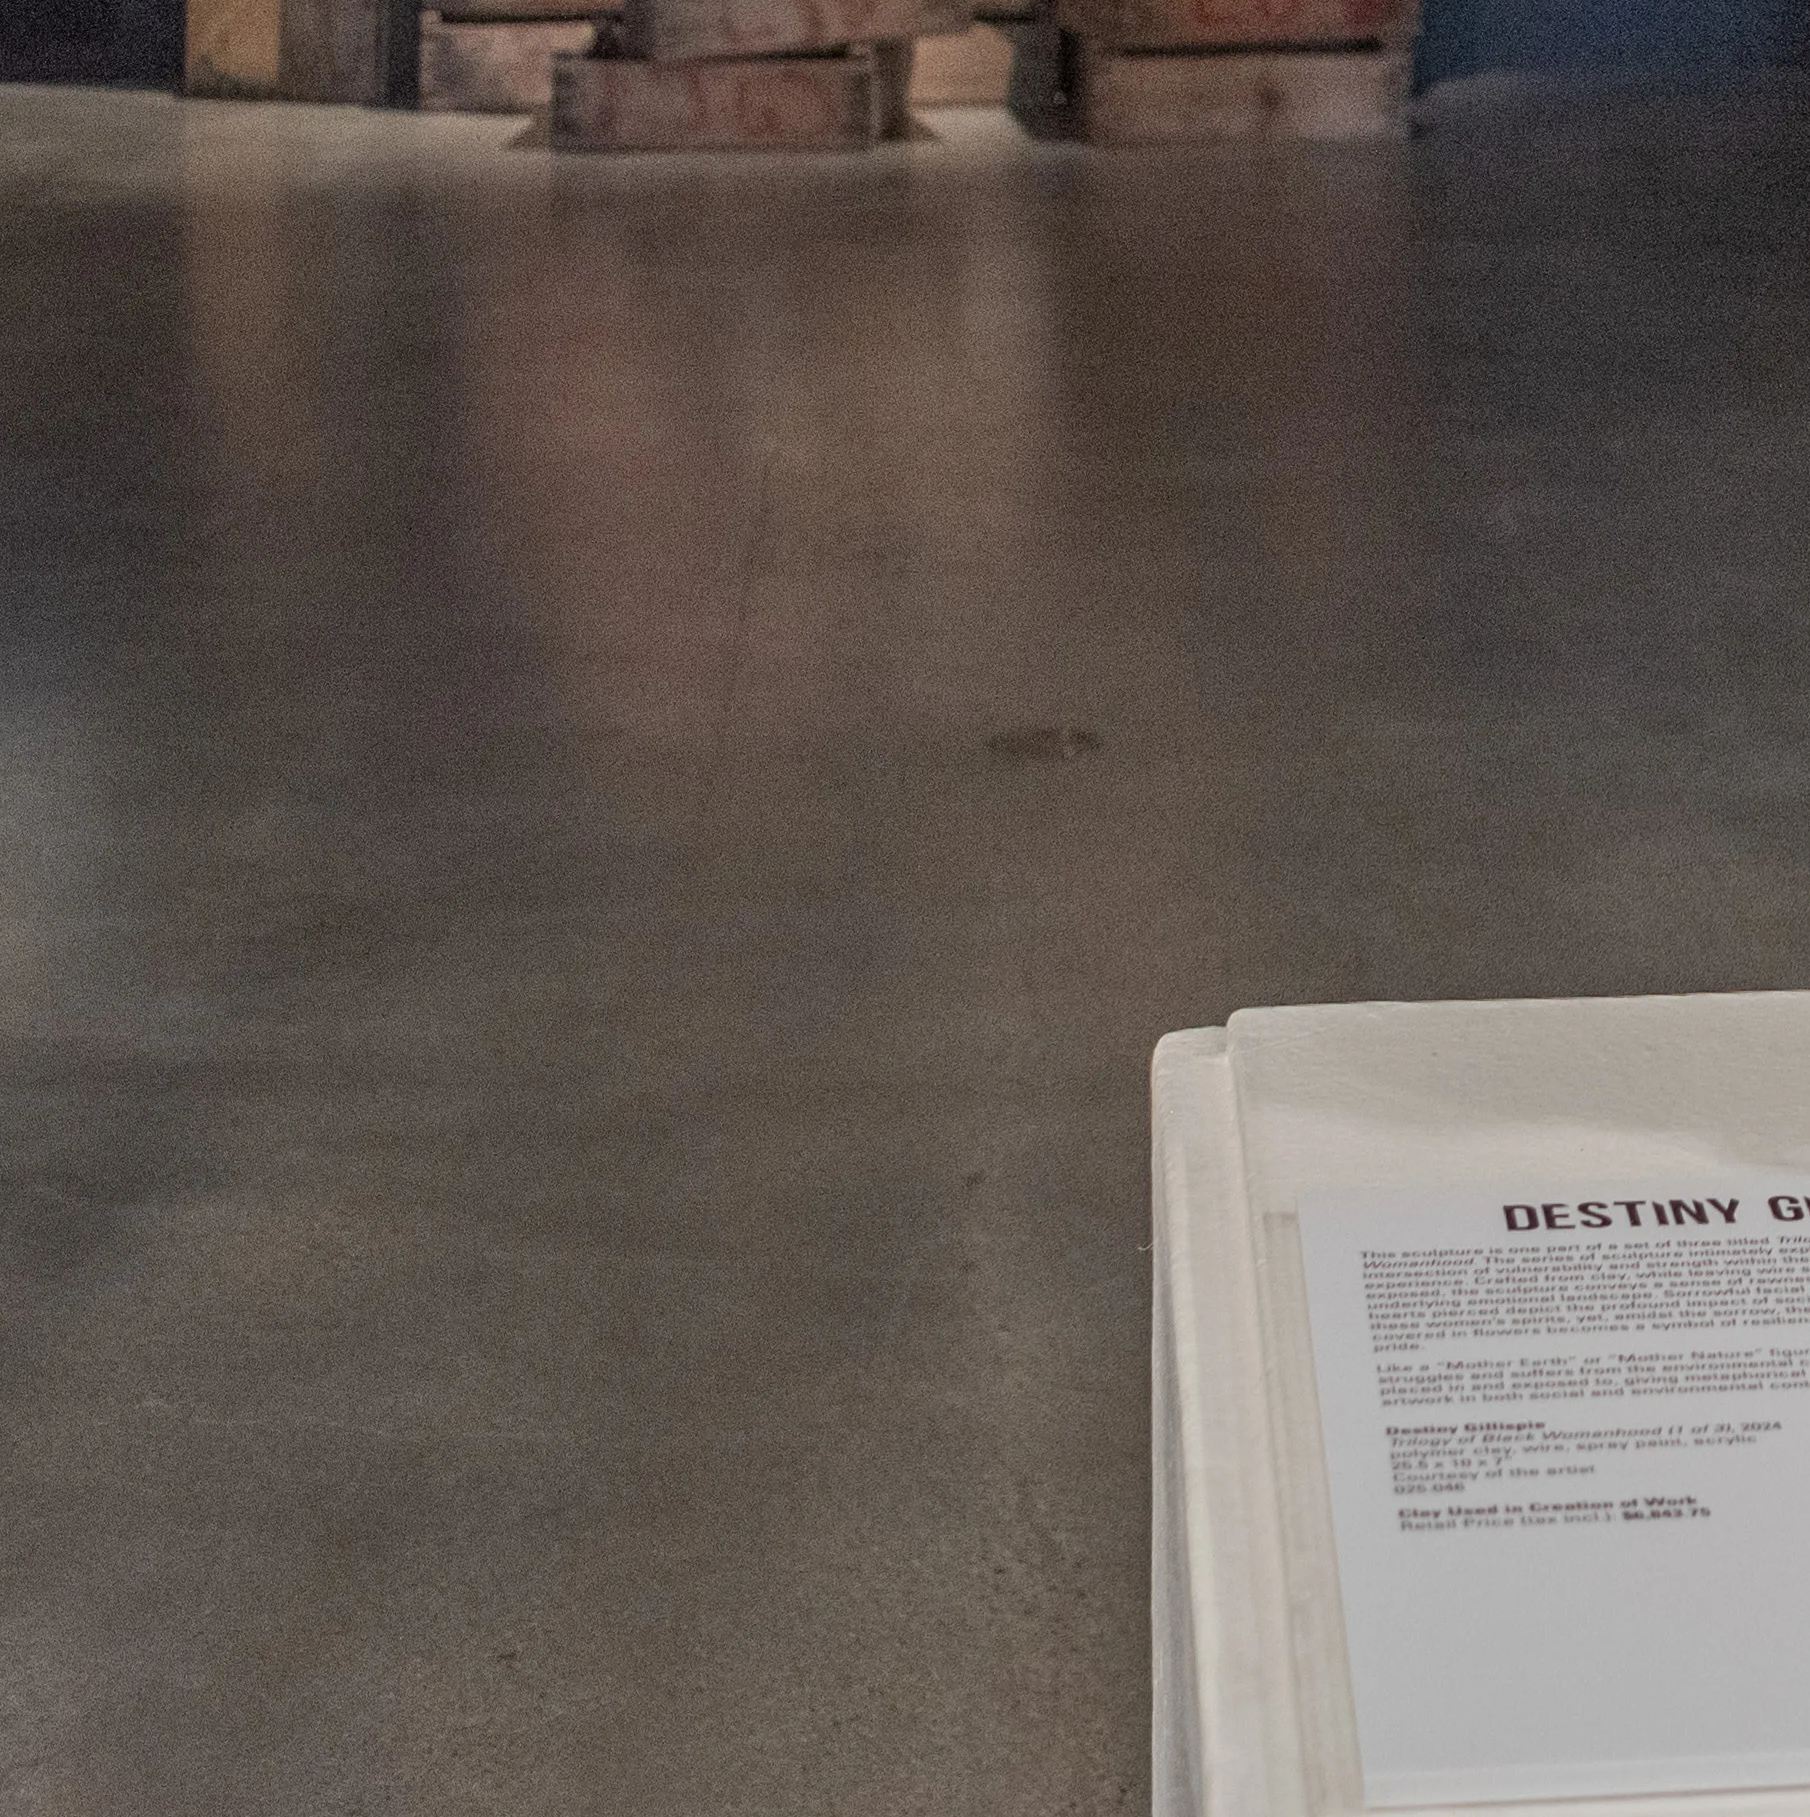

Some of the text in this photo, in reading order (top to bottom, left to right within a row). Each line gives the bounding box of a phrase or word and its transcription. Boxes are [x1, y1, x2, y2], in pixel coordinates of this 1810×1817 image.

[1502, 1197, 1740, 1232] DESTINY
[1360, 1250, 1396, 1259] This
[1400, 1246, 1483, 1259] sculpture
[1546, 1243, 1580, 1253] part
[1585, 1242, 1602, 1250] of
[1623, 1240, 1649, 1249] set
[1654, 1239, 1670, 1248] of
[1676, 1237, 1721, 1247] three
[1726, 1236, 1769, 1245] titled
[1484, 1255, 1515, 1264] The
[1520, 1253, 1574, 1263] series
[1579, 1252, 1595, 1261] of
[1601, 1249, 1683, 1261] sculpture
[1688, 1246, 1772, 1258] intimately
[1362, 1267, 1468, 1279] intersection
[1472, 1266, 1490, 1275] of
[1495, 1262, 1602, 1275] vulnerability
[1608, 1261, 1640, 1270] and
[1646, 1258, 1718, 1270] strength
[1723, 1255, 1776, 1265] within
[1782, 1254, 1809, 1263] the
[1474, 1274, 1538, 1285] Crafted
[1544, 1273, 1584, 1282] from
[1635, 1269, 1682, 1279] while
[1688, 1266, 1751, 1278] leaving
[1756, 1265, 1795, 1274] wire
[1366, 1298, 1461, 1311] underlying
[1466, 1294, 1555, 1306] emotional
[1663, 1287, 1750, 1298] Sorrowful
[1755, 1284, 1804, 1294] facial
[1450, 1287, 1478, 1296] the
[1484, 1283, 1568, 1296] sculpture
[1574, 1282, 1647, 1292] conveys
[1668, 1279, 1720, 1287] sense
[1726, 1277, 1742, 1285] of
[1368, 1309, 1426, 1320] hearts
[1431, 1307, 1499, 1318] pierced
[1505, 1304, 1560, 1315] depict
[1565, 1303, 1594, 1312] the
[1600, 1299, 1680, 1312] profound
[1686, 1297, 1746, 1308] impact
[1752, 1296, 1768, 1304] of
[1369, 1320, 1420, 1330] these
[1614, 1310, 1672, 1320] amidst
[1678, 1309, 1706, 1318] the
[1372, 1330, 1446, 1340] covered
[1450, 1329, 1466, 1337] in
[1472, 1326, 1540, 1336] flowers
[1546, 1322, 1629, 1333] becomes
[1651, 1319, 1714, 1331] symbol
[1720, 1318, 1736, 1327] of
[1376, 1362, 1412, 1371] Like
[1378, 1371, 1464, 1384] struggles
[1470, 1370, 1504, 1379] and
[1510, 1367, 1574, 1377] suffers
[1578, 1365, 1622, 1375] from
[1626, 1364, 1656, 1373] the
[1661, 1358, 1793, 1371] environmental
[1379, 1383, 1442, 1395] placed
[1448, 1382, 1464, 1391] in
[1470, 1381, 1504, 1390] and
[1510, 1377, 1589, 1390] exposed
[1623, 1374, 1678, 1385] giving
[1684, 1368, 1806, 1382] metaphorical
[1381, 1394, 1453, 1405] artwork
[1481, 1391, 1523, 1401] both
[1528, 1389, 1584, 1399] social
[1590, 1387, 1624, 1396] and
[1630, 1381, 1763, 1395] environmental
[1384, 1420, 1545, 1435] Destiny Gillispie
[1390, 1421, 1782, 1447] Trilogy of Black Womanhood of 2024
[1389, 1447, 1464, 1459] polymer
[1575, 1442, 1628, 1451] spray
[1692, 1434, 1756, 1446] acrylic
[1392, 1464, 1595, 1482] Courtesy of the artist
[1397, 1496, 1696, 1518] Clay Used in Creation of Work
